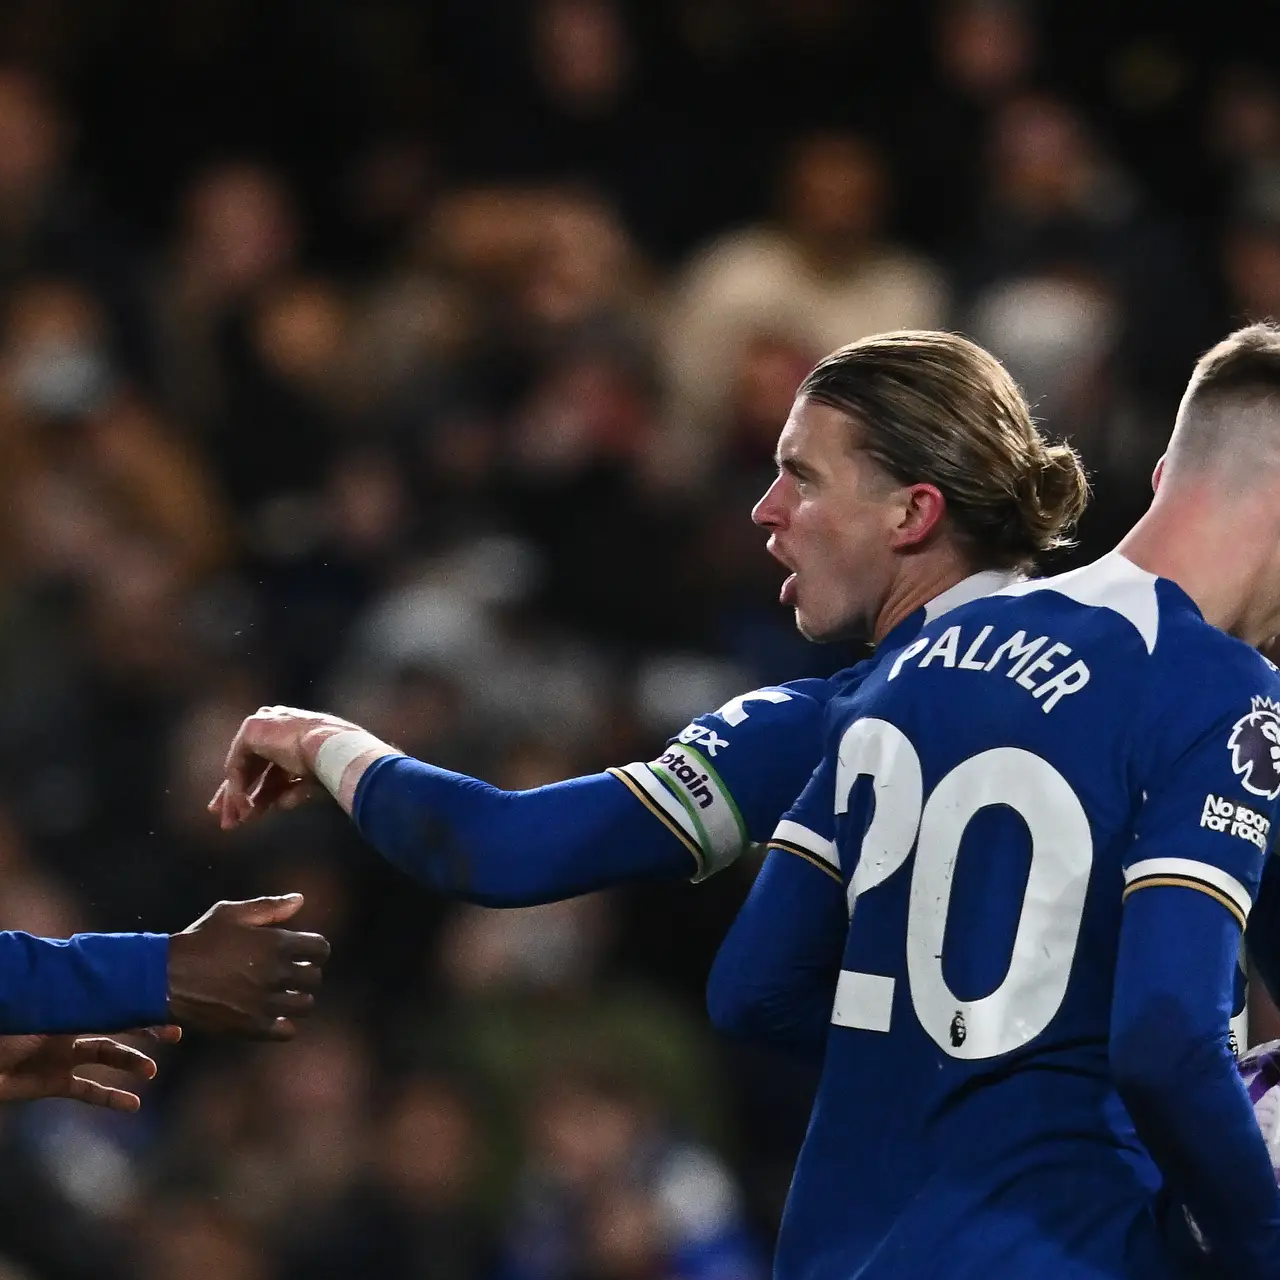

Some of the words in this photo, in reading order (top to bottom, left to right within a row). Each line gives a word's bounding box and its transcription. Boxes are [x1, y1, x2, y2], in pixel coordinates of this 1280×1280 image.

[887, 624, 1091, 714] PALMER
[1204, 793, 1235, 818] No
[830, 716, 1094, 1060] 20
